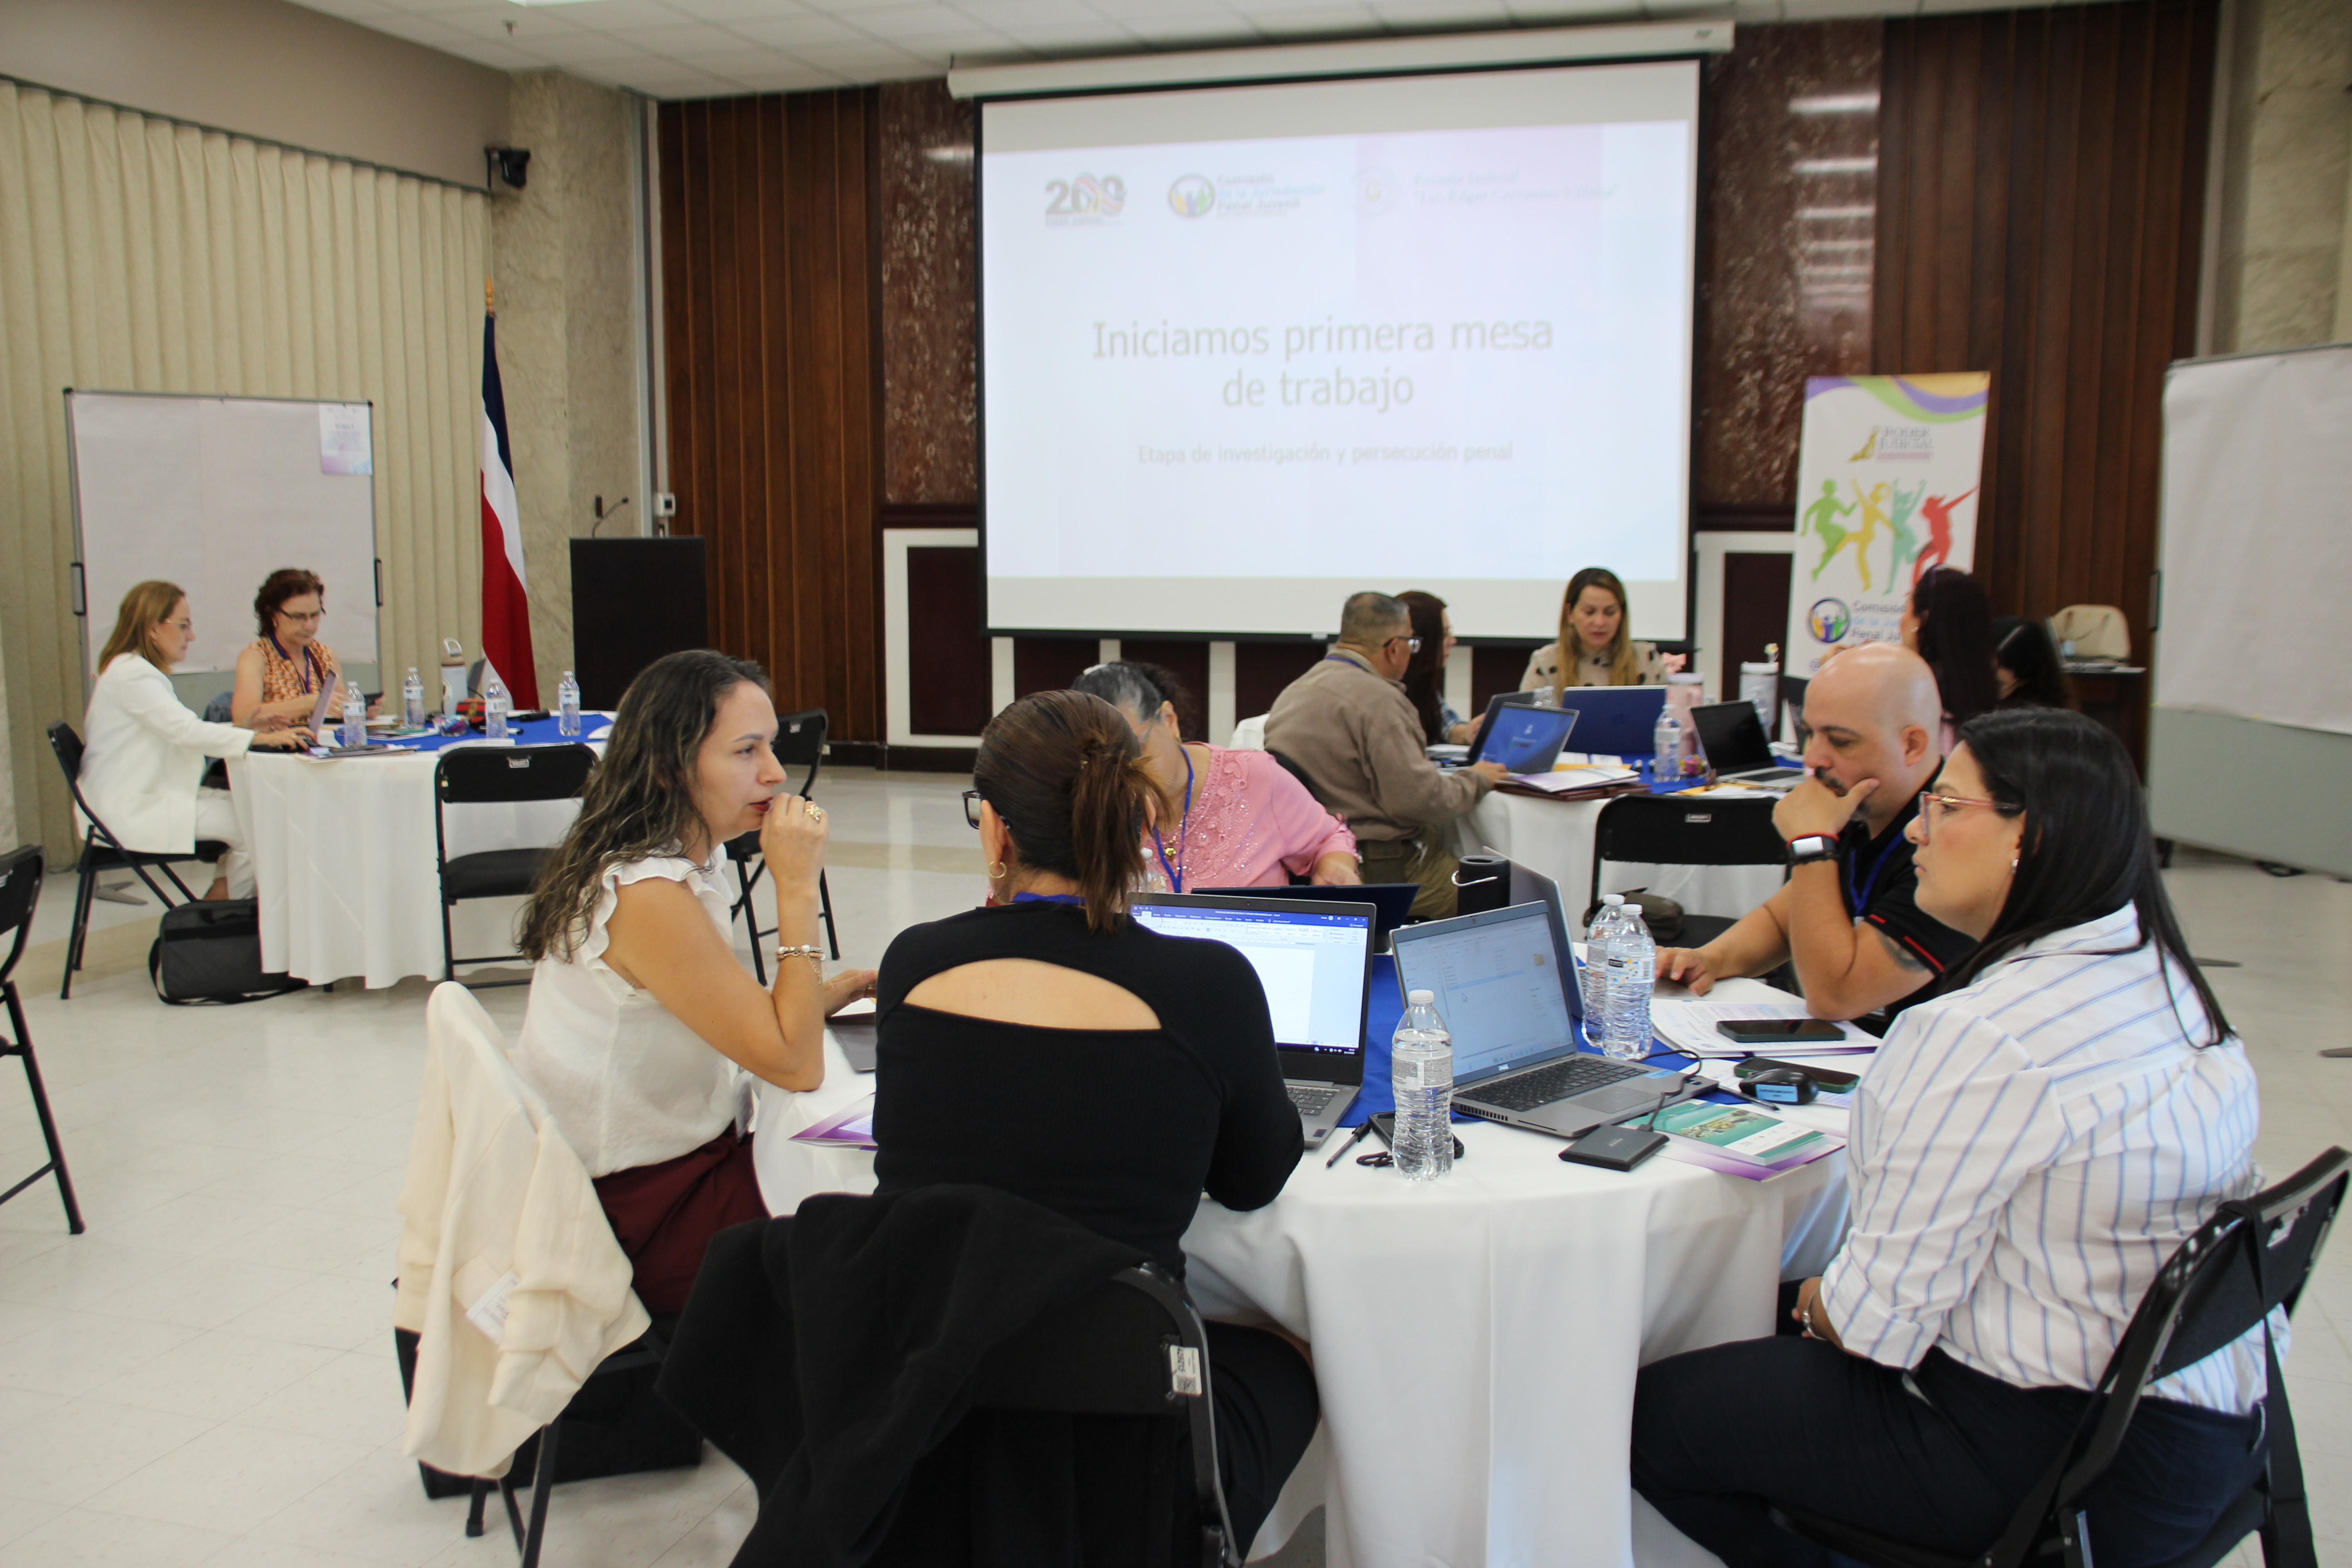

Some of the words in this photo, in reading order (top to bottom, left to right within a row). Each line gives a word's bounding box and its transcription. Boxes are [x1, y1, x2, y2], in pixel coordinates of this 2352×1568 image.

[1092, 319, 1270, 358] Iniciamos
[1284, 314, 1435, 363] primera
[1451, 319, 1553, 350] mesa
[1221, 368, 1266, 407] de
[1279, 366, 1415, 414] trabajo
[1138, 445, 1186, 465] Etapa
[1191, 445, 1212, 462] de
[1218, 442, 1330, 465] investigación
[1336, 448, 1346, 464] y
[1352, 442, 1457, 464] persecución
[1464, 441, 1513, 463] penal
